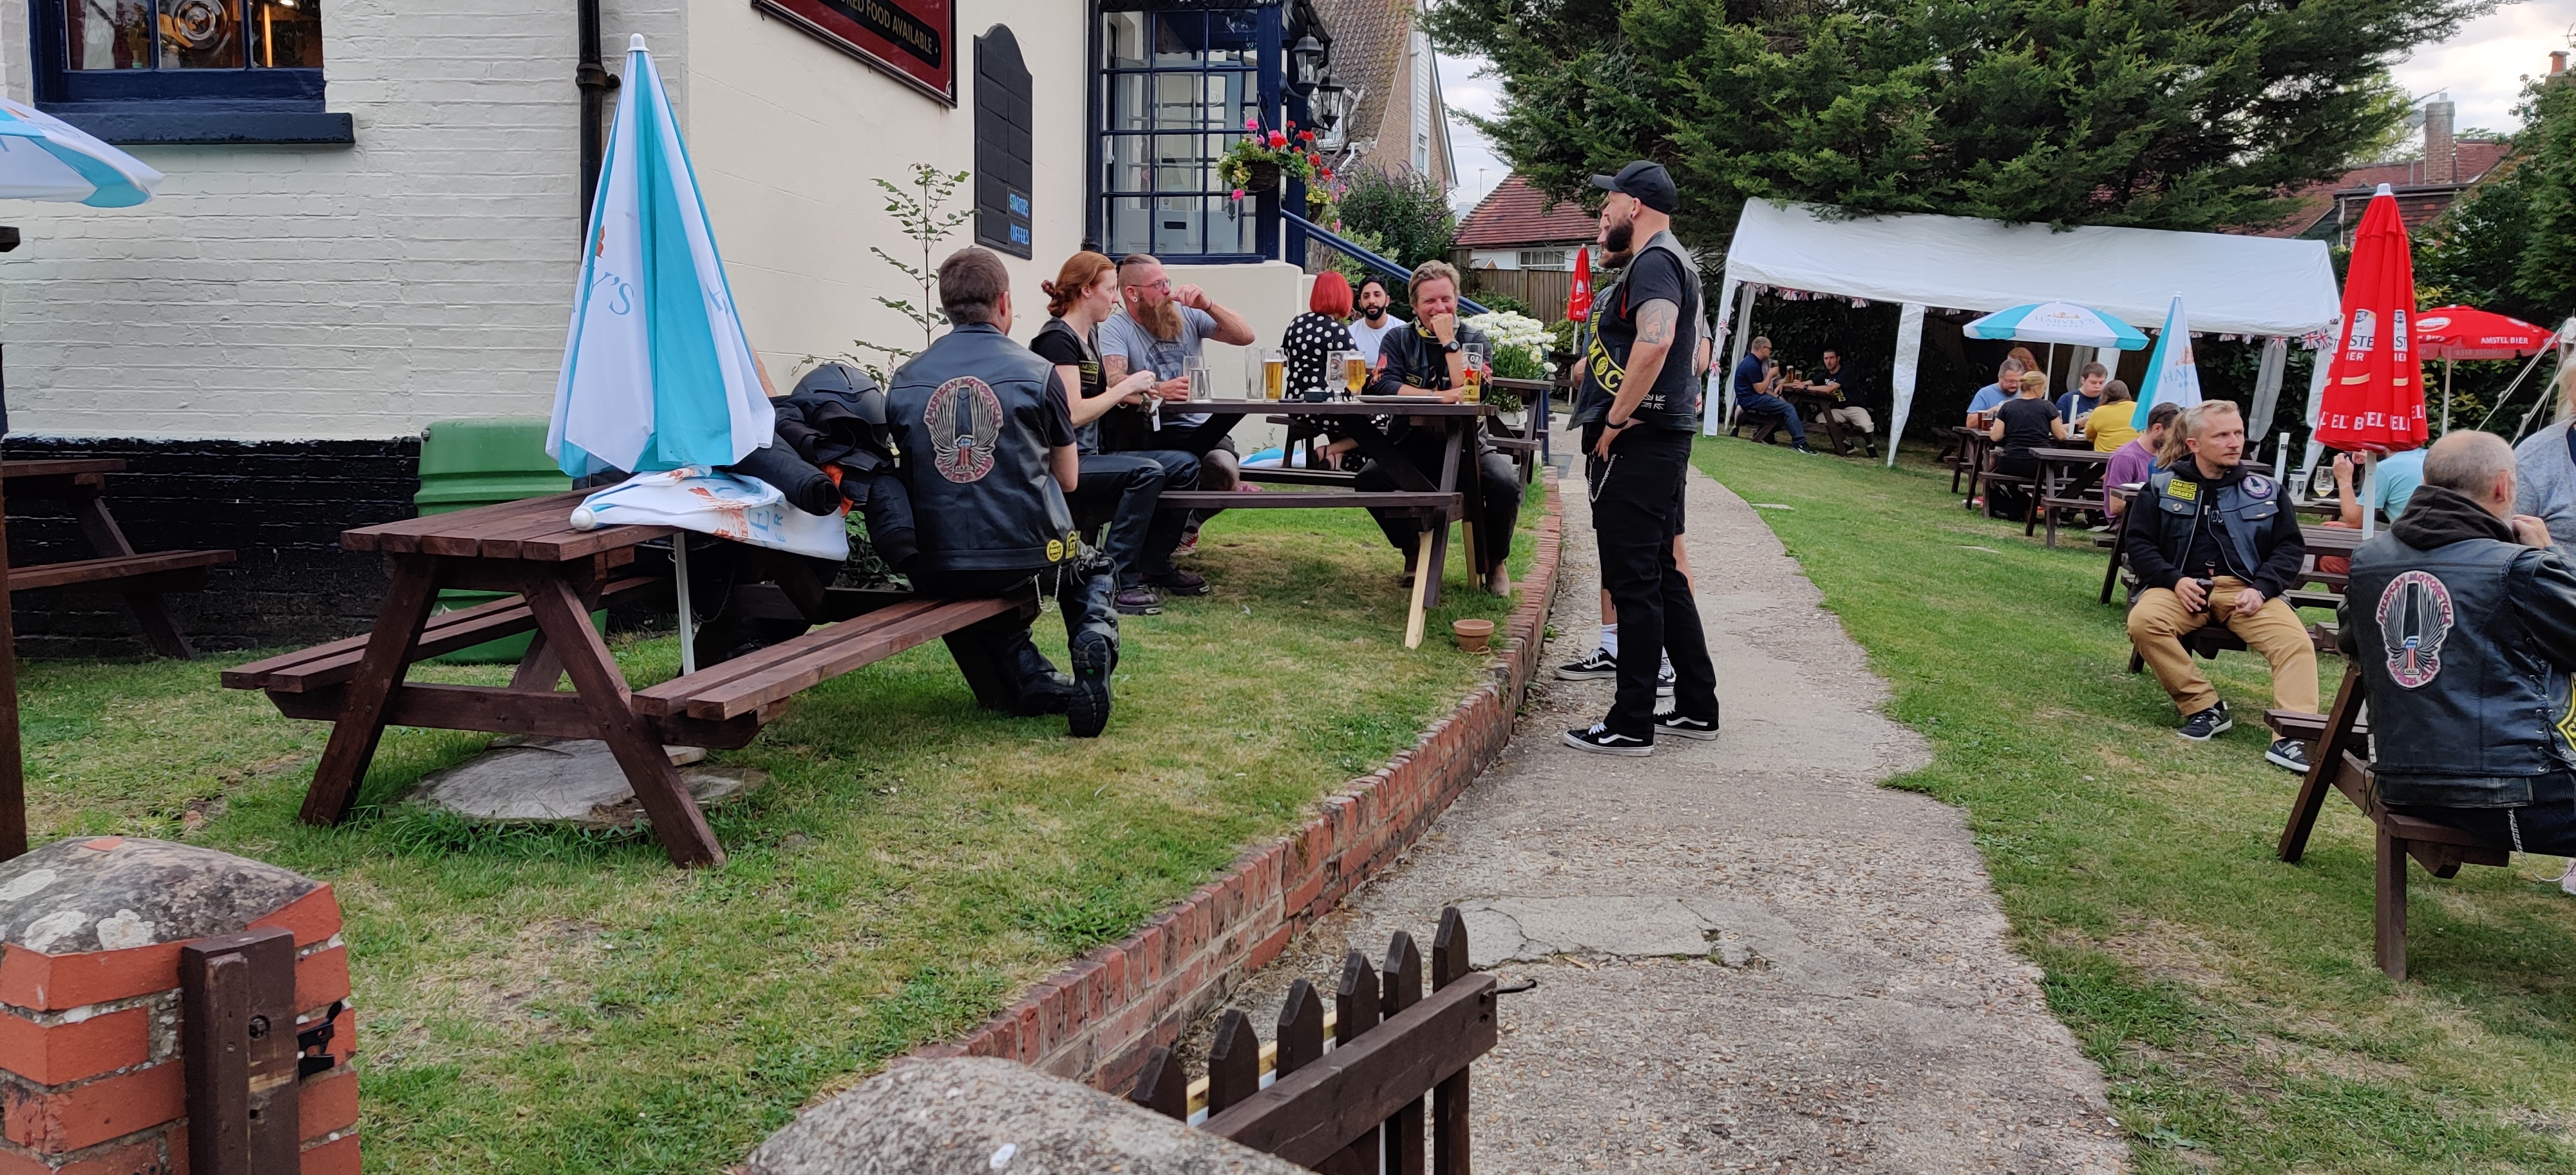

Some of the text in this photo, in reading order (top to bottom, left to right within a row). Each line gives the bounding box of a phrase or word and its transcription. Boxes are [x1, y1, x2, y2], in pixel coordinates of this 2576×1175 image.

[866, 0, 891, 28] FOOD
[893, 15, 933, 55] AVAILABLE
[1009, 193, 1029, 218] STARTERS
[2480, 336, 2529, 345] AMSTEL BIER
[925, 379, 958, 426] AMERICAN
[2170, 488, 2193, 499] SUSSEX
[2378, 575, 2406, 625] AMERICAN
[2408, 573, 2452, 626] MOTORCYCLE
